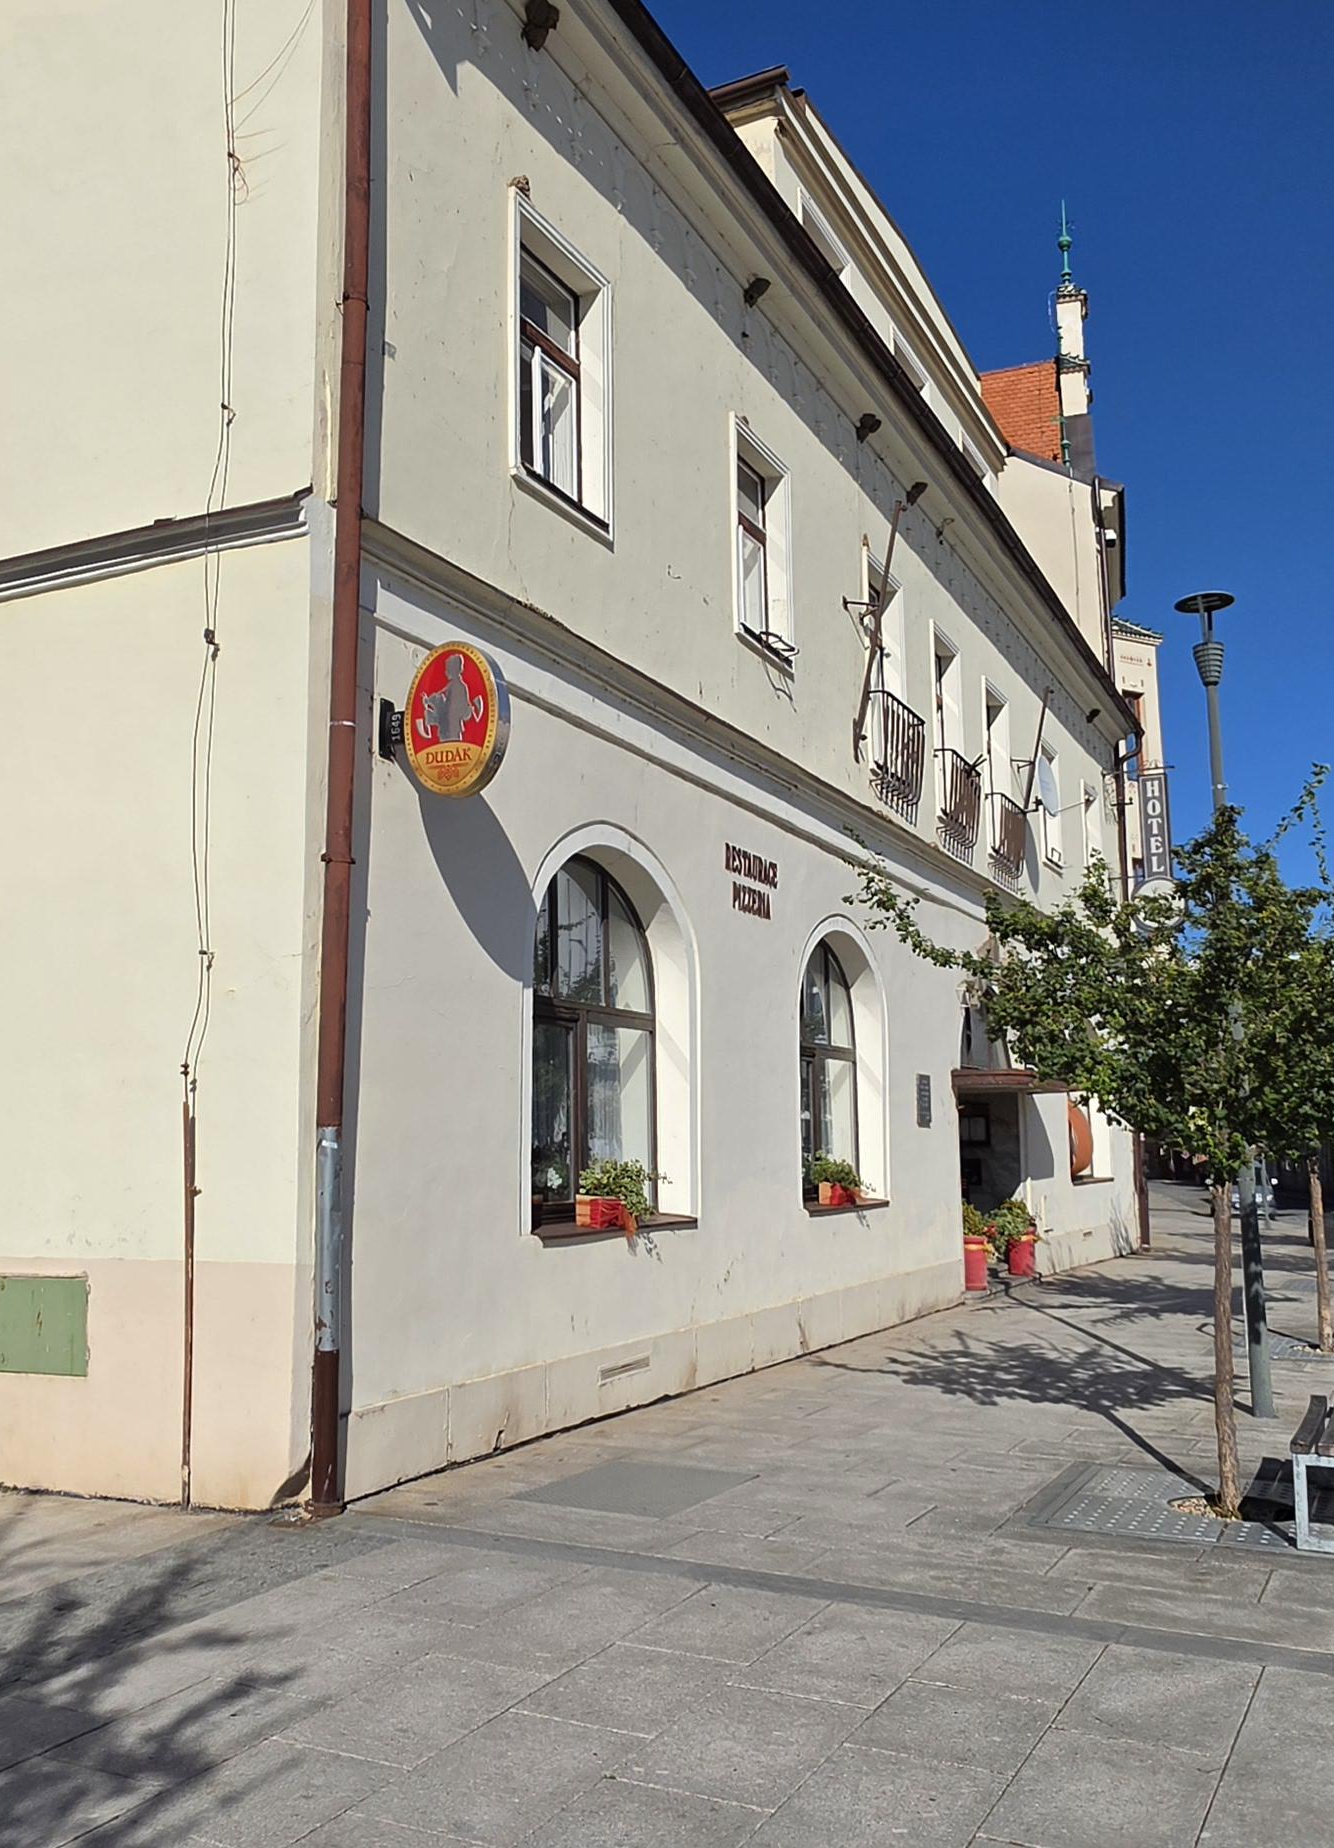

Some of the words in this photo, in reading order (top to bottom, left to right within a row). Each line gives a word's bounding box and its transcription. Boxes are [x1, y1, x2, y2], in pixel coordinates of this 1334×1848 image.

[391, 713, 401, 741] 1649
[425, 747, 471, 765] DUDÁK
[1145, 780, 1164, 872] HOTEL
[724, 841, 778, 889] RESTAURACE
[732, 881, 771, 920] PIZZERIA
